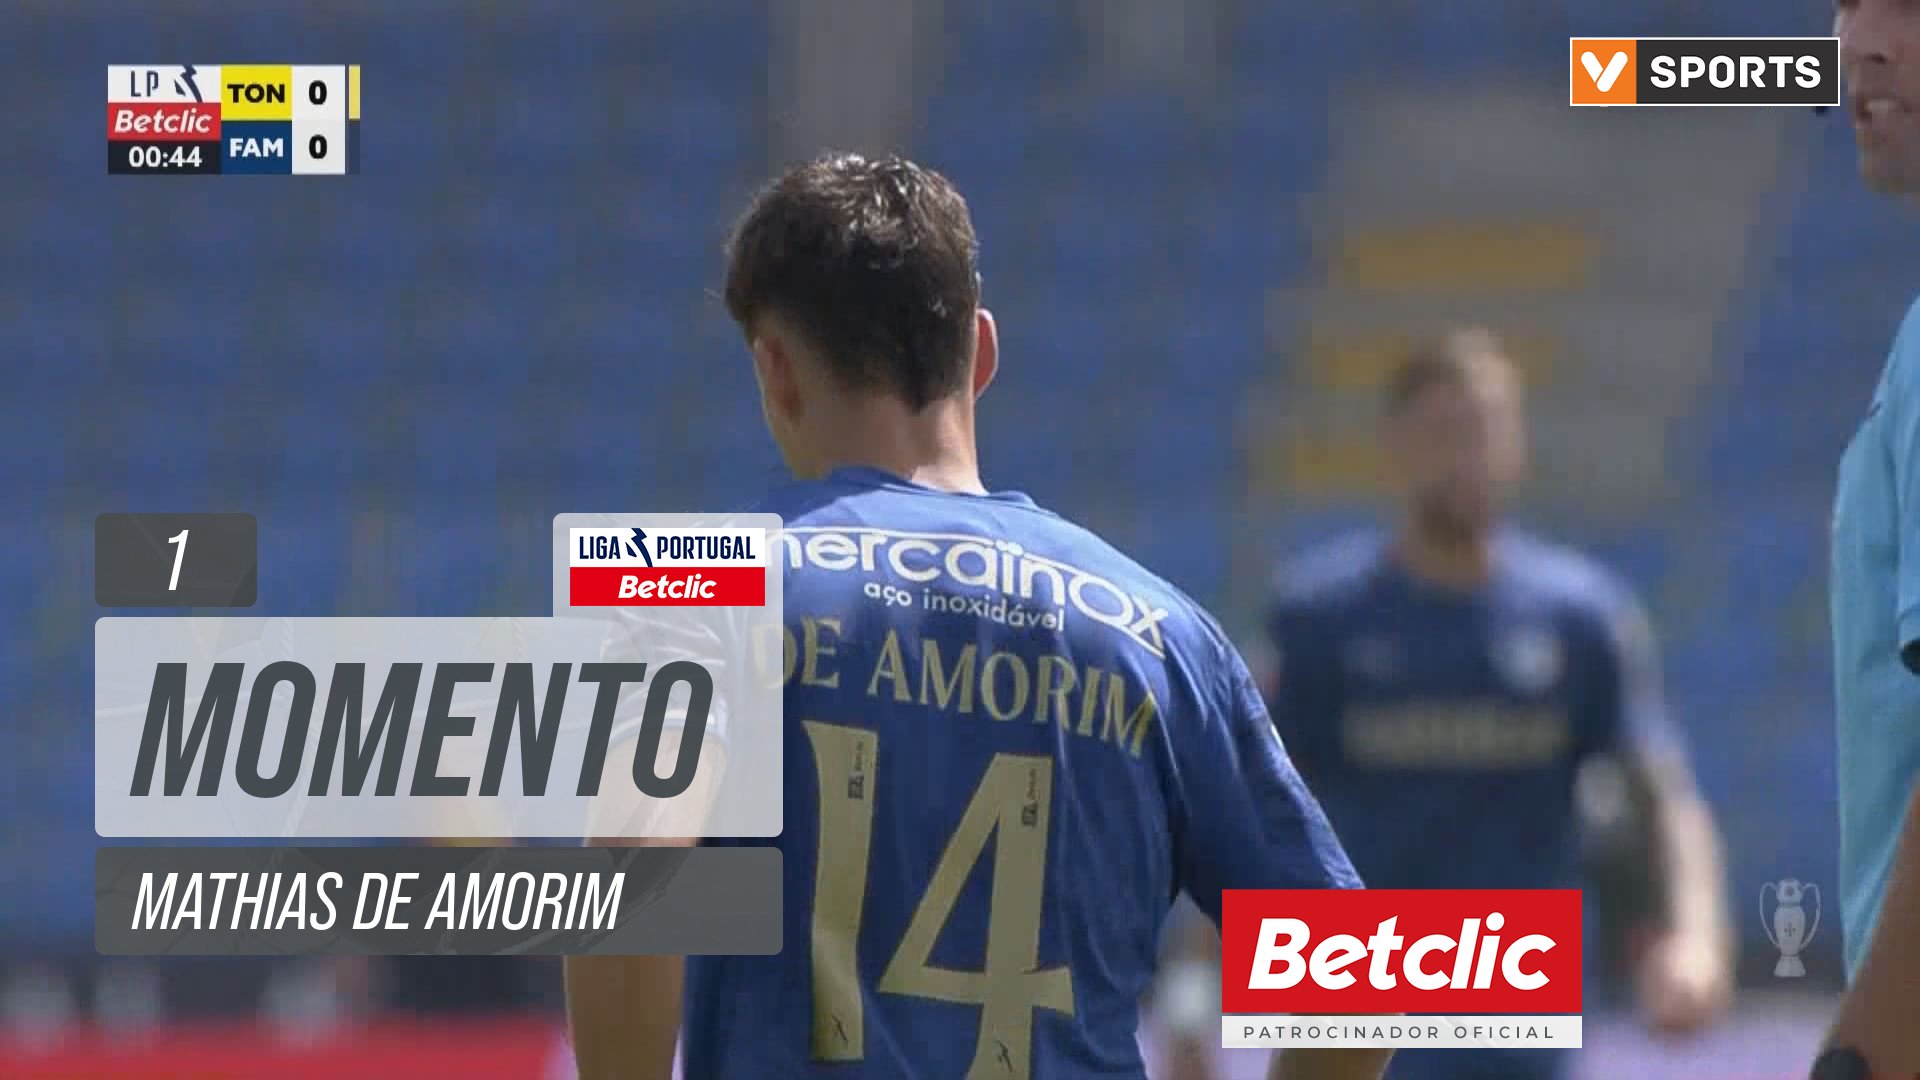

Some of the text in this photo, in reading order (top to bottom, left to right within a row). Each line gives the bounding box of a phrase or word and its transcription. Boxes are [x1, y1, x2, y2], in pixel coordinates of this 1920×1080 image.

[864, 582, 1064, 632] aço inoxidável
[866, 627, 1156, 759] AMORIM
[802, 719, 1075, 1080] 14
